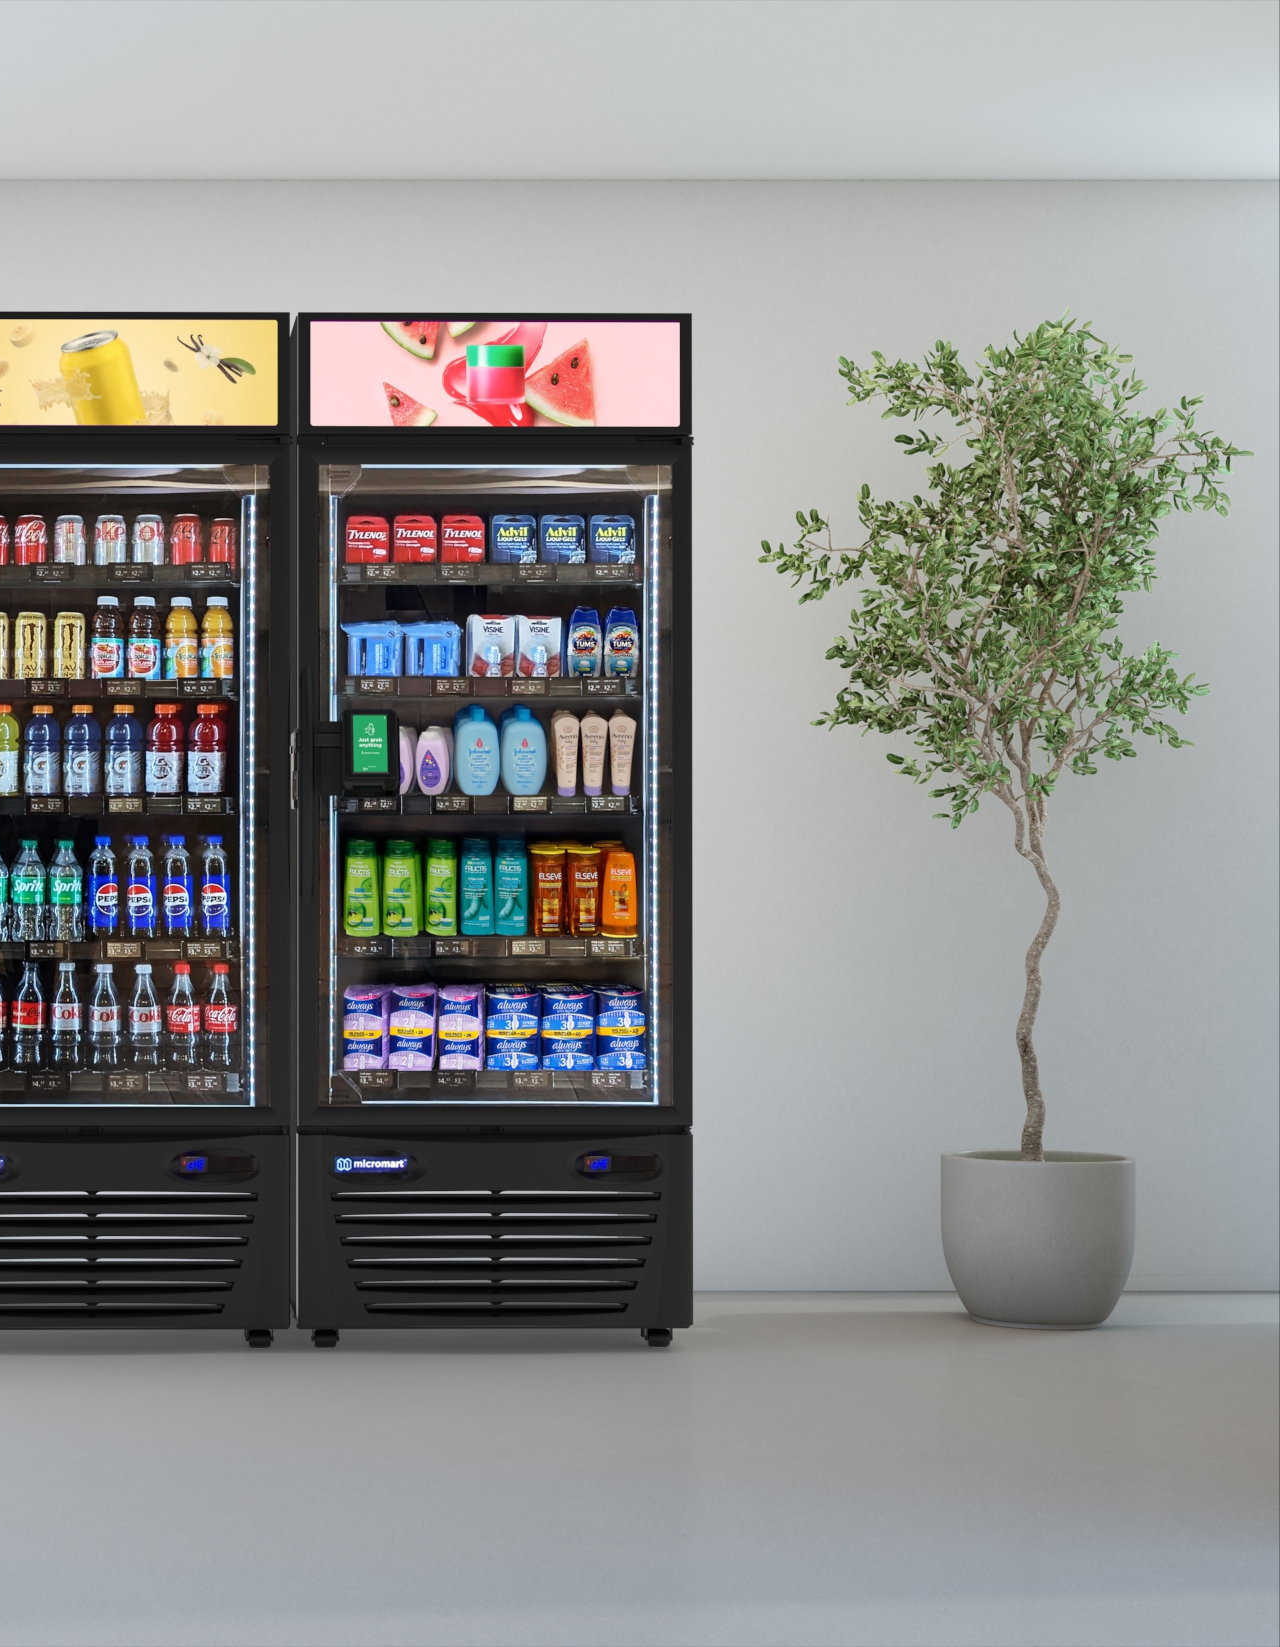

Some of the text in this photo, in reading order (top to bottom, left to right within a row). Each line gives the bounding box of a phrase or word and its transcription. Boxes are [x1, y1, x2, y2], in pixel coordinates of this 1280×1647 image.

[396, 528, 434, 538] TYLENOL
[444, 528, 482, 538] TYLENOL
[497, 527, 528, 536] Advil
[546, 527, 577, 536] Advil
[595, 527, 627, 536] Advil
[347, 1001, 373, 1013] always
[399, 998, 425, 1009] always
[445, 1002, 471, 1013] always
[497, 1000, 528, 1012] always
[553, 1000, 583, 1012] always
[609, 997, 637, 1009] always
[52, 1006, 82, 1019] Coke
[353, 1021, 357, 1029] 2
[404, 1018, 408, 1026] 2
[451, 1022, 456, 1030] 2
[505, 1021, 511, 1030] 3
[561, 1021, 567, 1030] 3
[618, 1018, 624, 1026] 3
[348, 1041, 374, 1052] always
[397, 1039, 423, 1050] always
[445, 1042, 472, 1052] always
[497, 1039, 526, 1052] always
[552, 1039, 582, 1052] always
[610, 1037, 639, 1050] always
[402, 1057, 407, 1065] 2
[505, 1058, 511, 1066] 3
[560, 1058, 566, 1066] 3
[619, 1057, 625, 1066] 3
[354, 1159, 405, 1168] micromart
